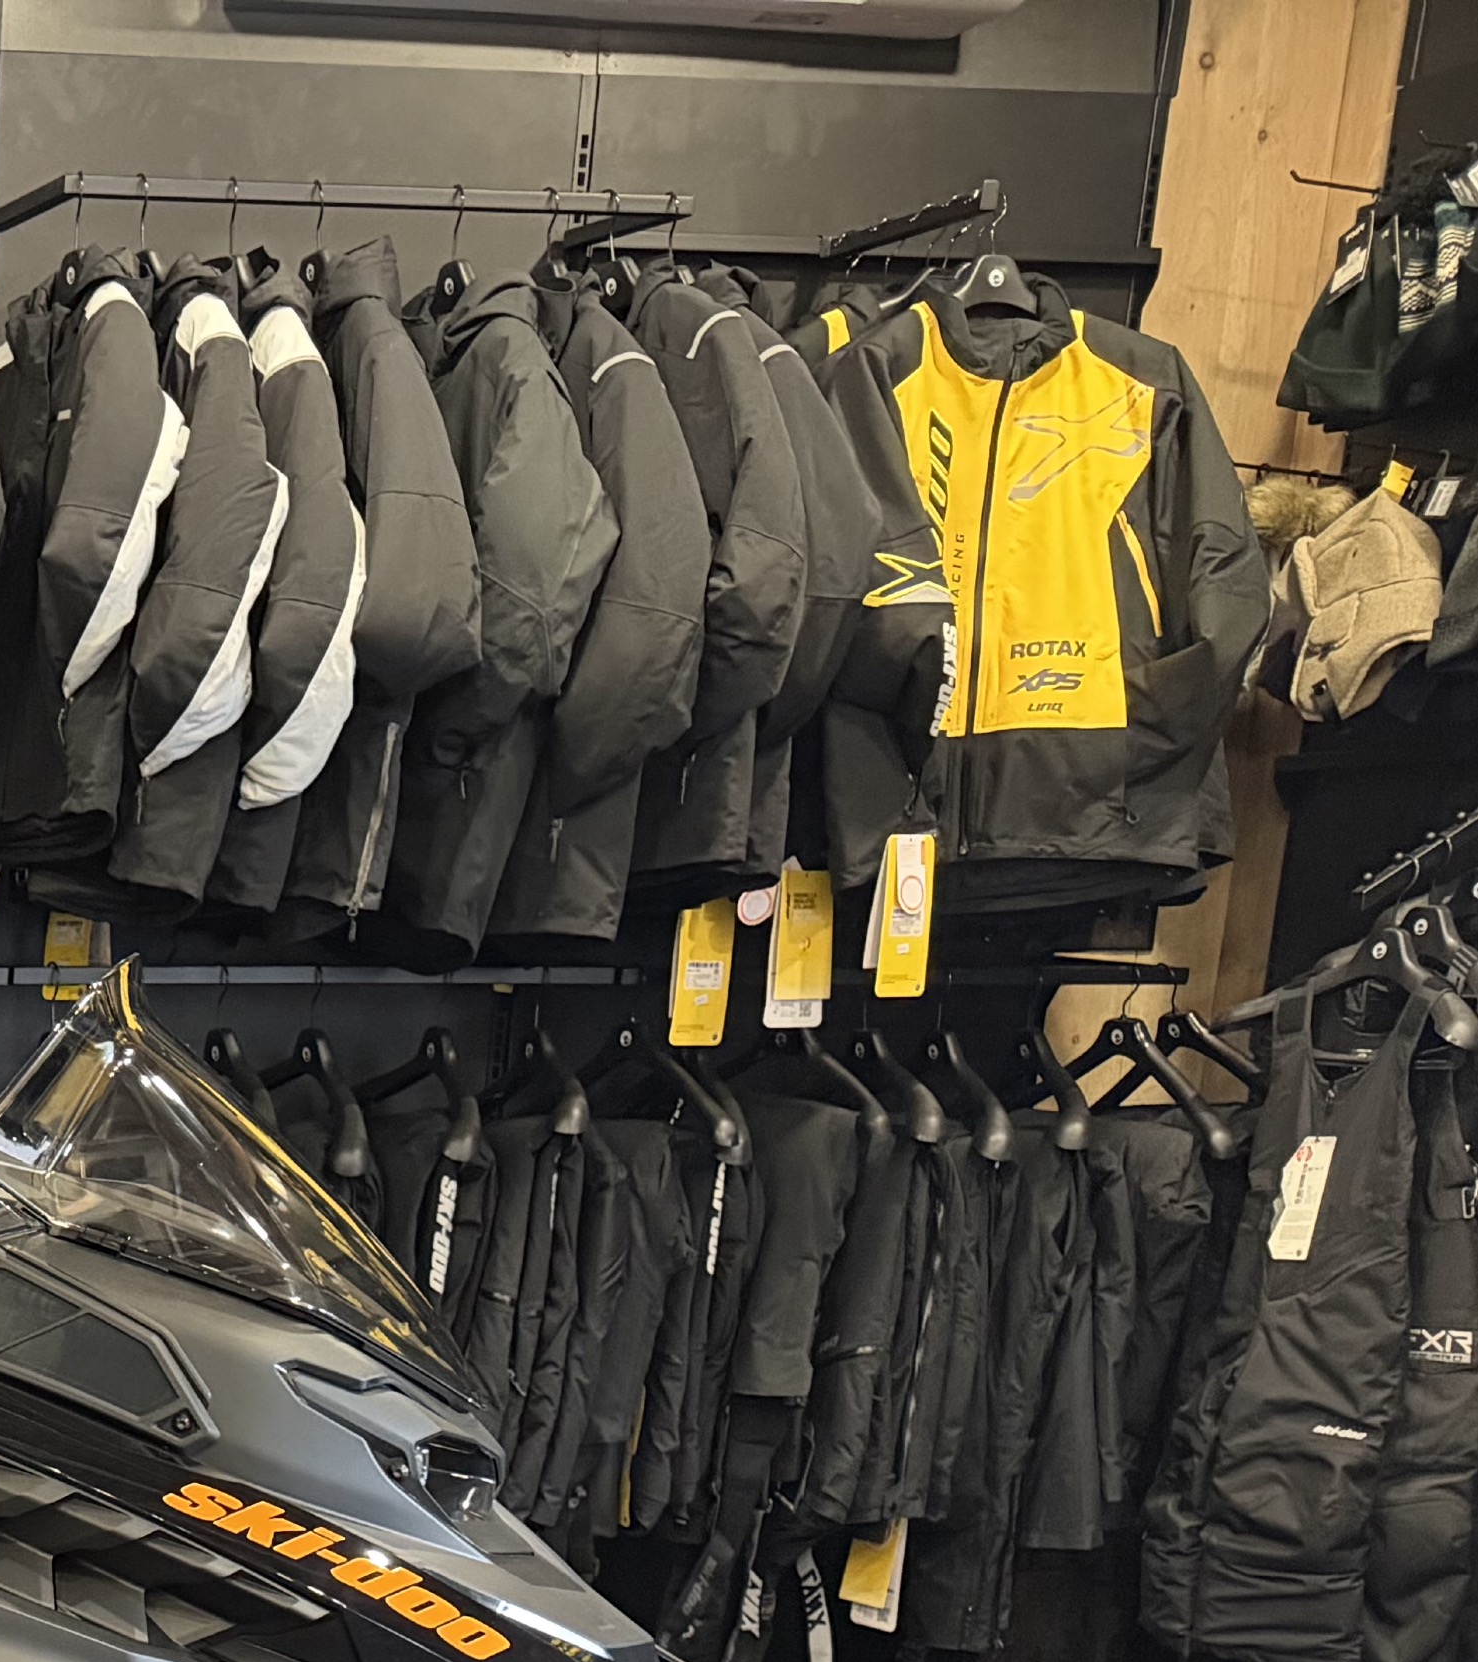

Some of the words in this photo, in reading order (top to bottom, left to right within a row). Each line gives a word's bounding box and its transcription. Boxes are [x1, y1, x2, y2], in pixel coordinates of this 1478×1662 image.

[1010, 641, 1087, 660] ROTAX
[1312, 1425, 1367, 1440] ski-doo
[162, 1482, 511, 1661] ski-doo
